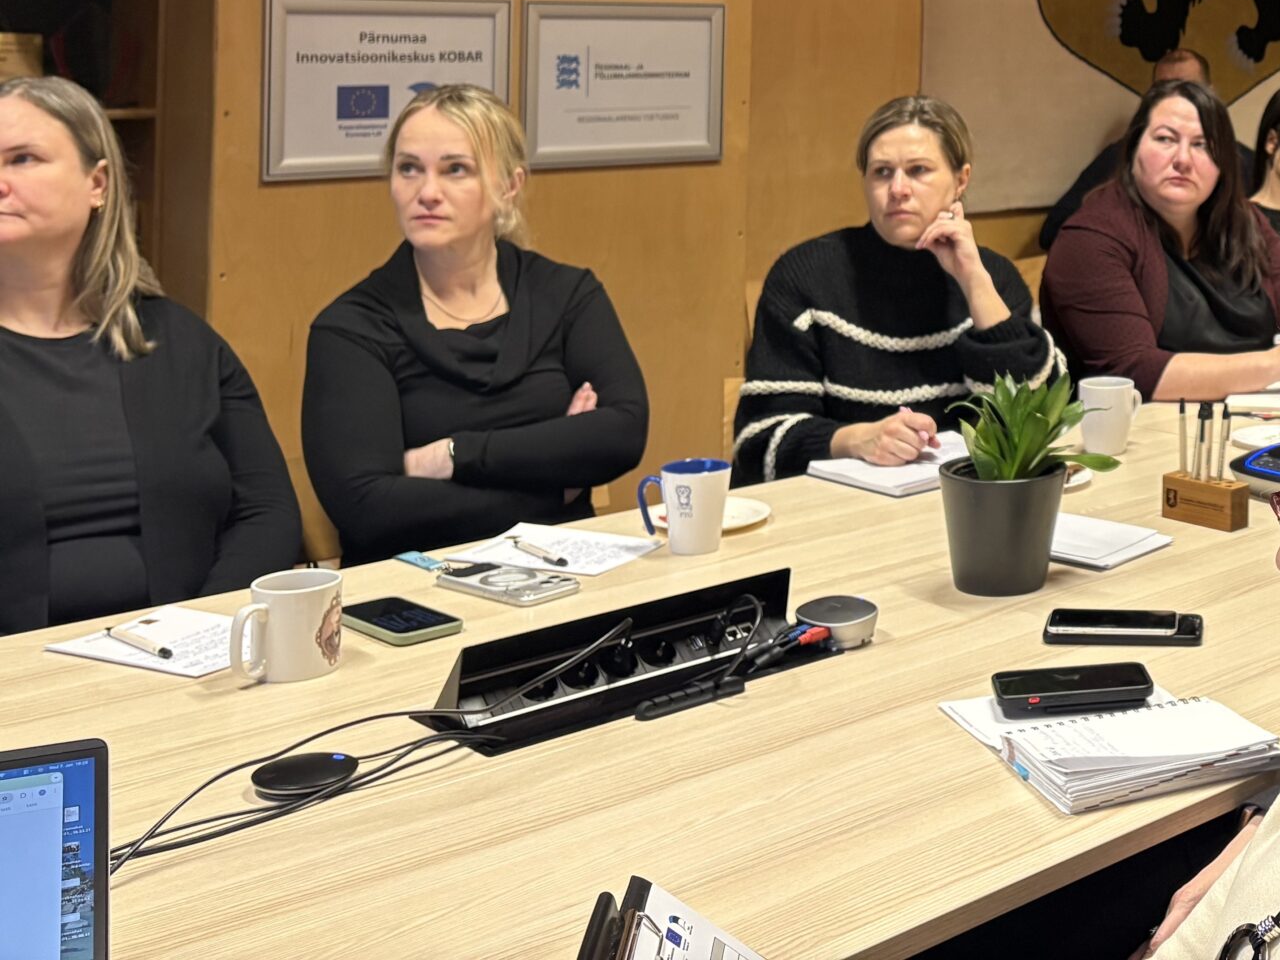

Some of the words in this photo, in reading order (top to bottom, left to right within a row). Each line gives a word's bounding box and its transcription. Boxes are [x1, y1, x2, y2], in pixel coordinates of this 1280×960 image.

[359, 31, 427, 44] Pärnumaa
[296, 51, 435, 64] Innovatsioonikeskus
[439, 50, 482, 63] KOBAR
